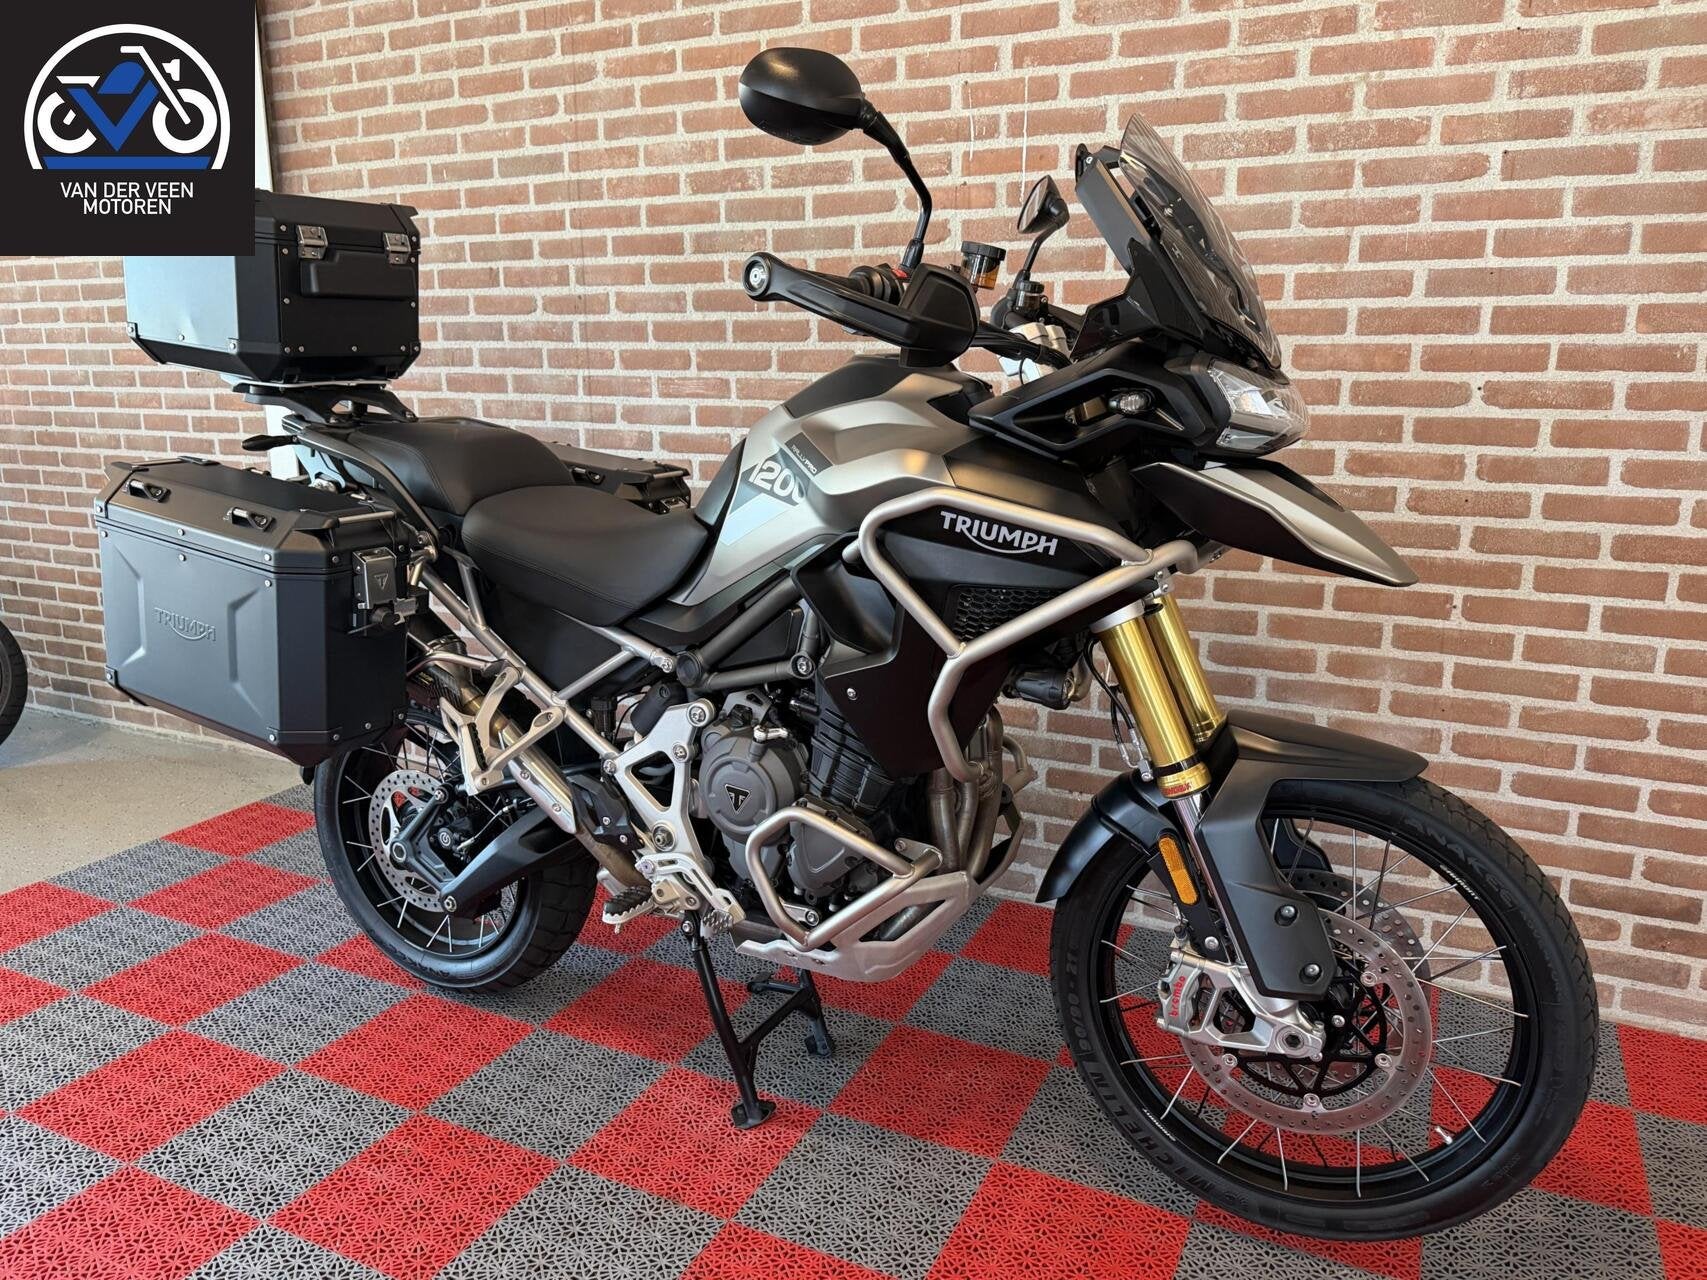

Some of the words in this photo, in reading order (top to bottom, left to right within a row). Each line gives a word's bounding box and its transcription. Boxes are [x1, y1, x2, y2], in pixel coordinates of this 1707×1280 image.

[940, 510, 1058, 556] TRIUMPH
[153, 606, 216, 642] TRIUMPH
[1168, 975, 1186, 1017] brembo
[1088, 1067, 1217, 1198] MICHELIN
